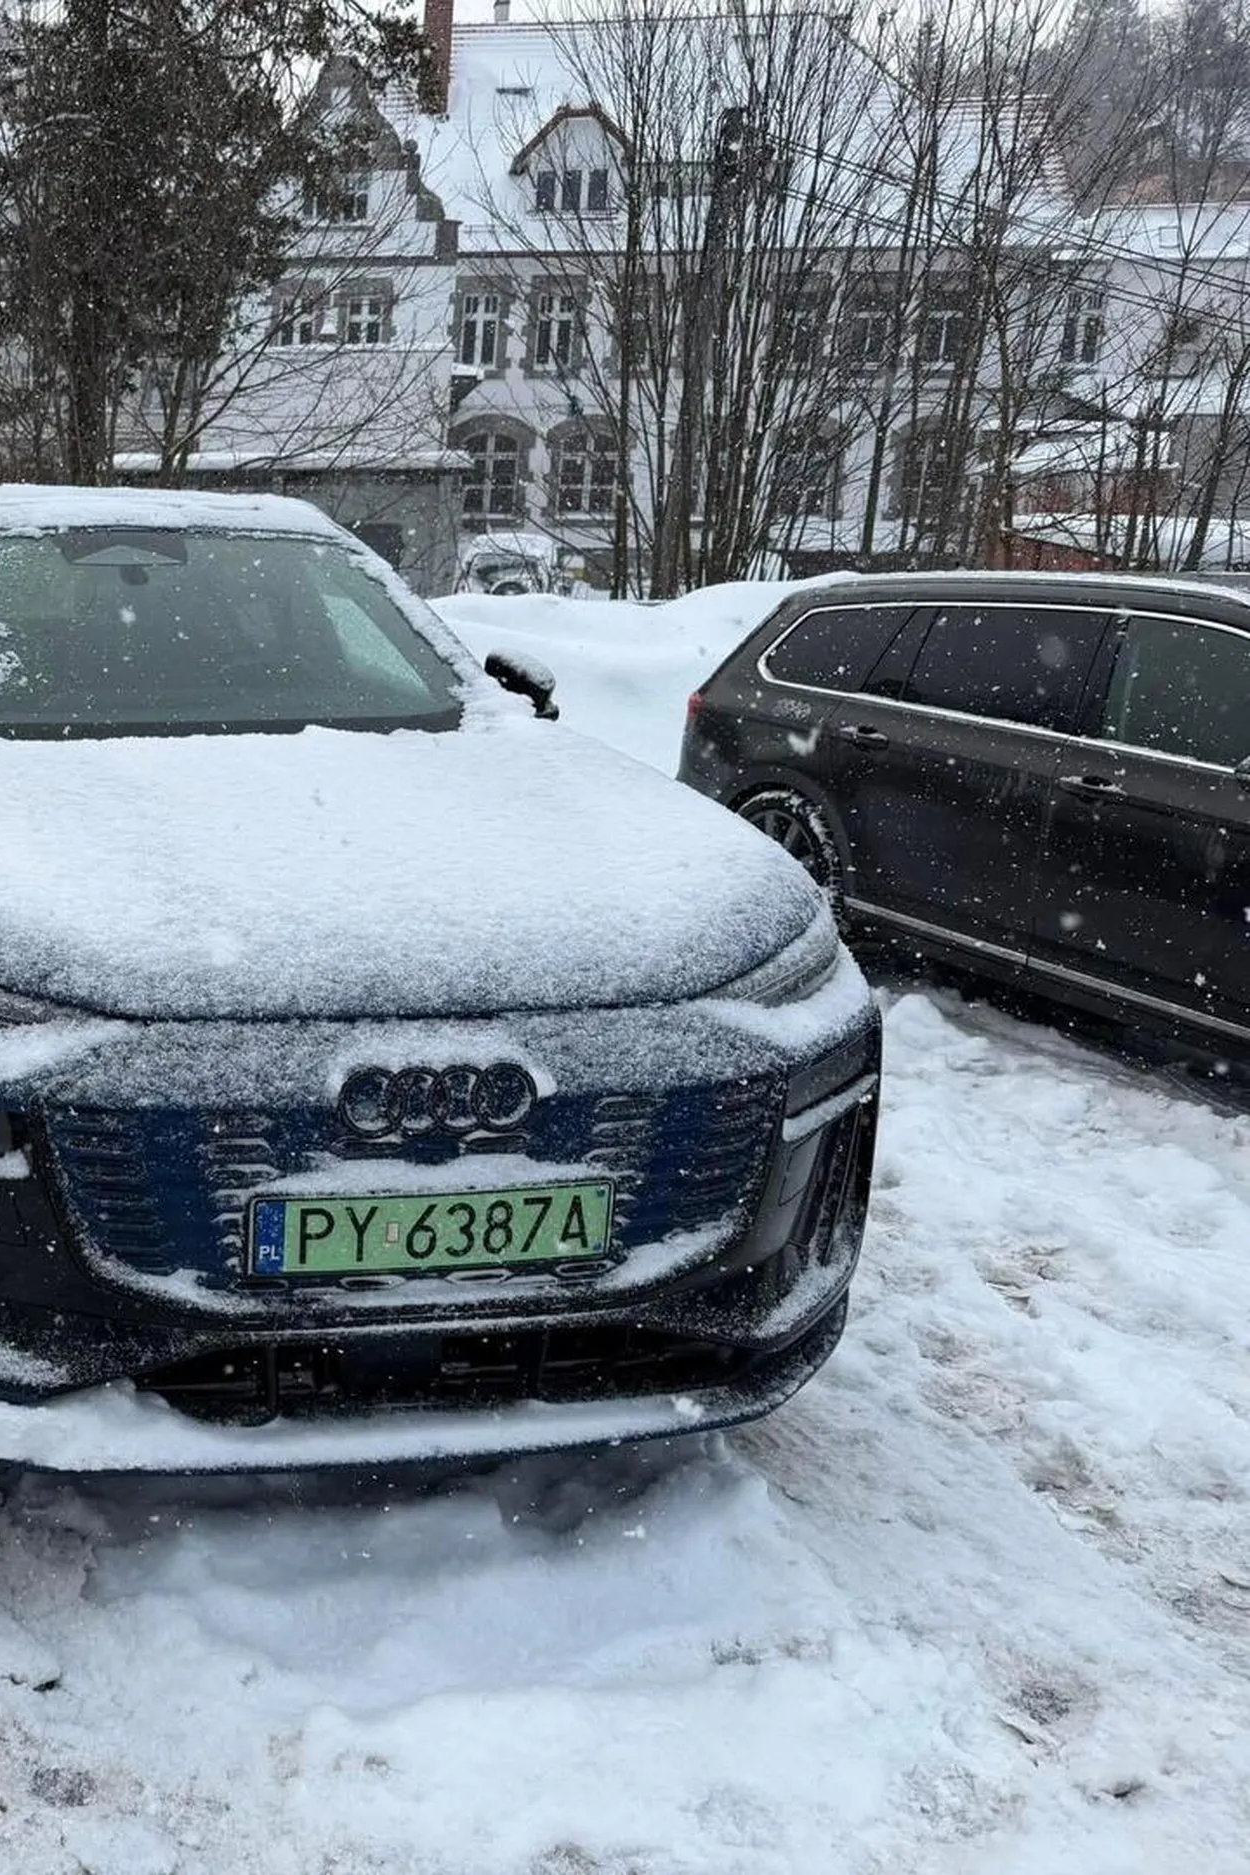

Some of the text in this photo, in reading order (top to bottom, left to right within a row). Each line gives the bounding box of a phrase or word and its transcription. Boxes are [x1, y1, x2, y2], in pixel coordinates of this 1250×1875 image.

[298, 1194, 589, 1265] PY 6387A
[258, 1245, 281, 1261] PL
